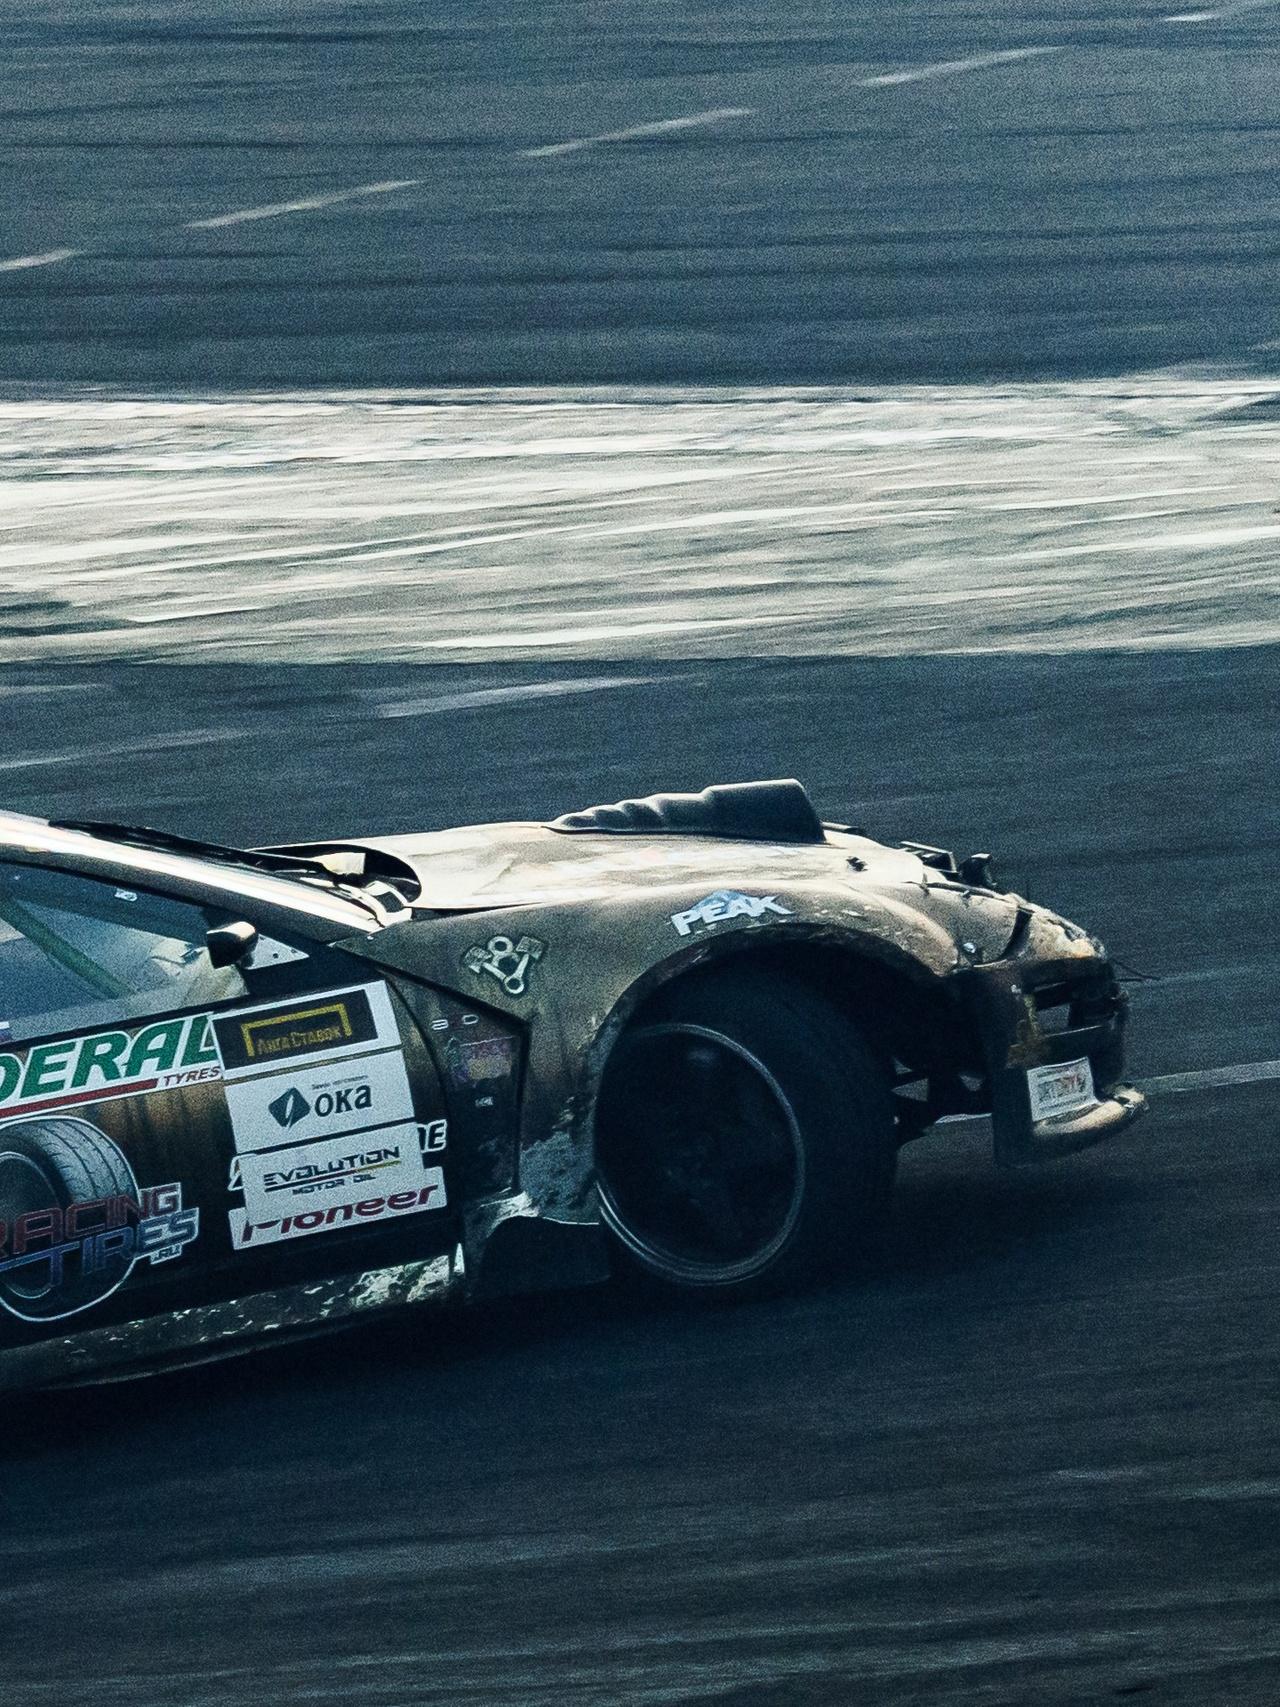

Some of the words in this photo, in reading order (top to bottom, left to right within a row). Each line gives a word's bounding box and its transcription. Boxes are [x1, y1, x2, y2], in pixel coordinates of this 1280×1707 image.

[670, 894, 793, 936] PEAK
[161, 1065, 220, 1088] TYRES
[263, 1146, 400, 1187] EVOLUTION
[292, 1178, 345, 1195] MOTOR
[353, 1173, 376, 1184] OIL
